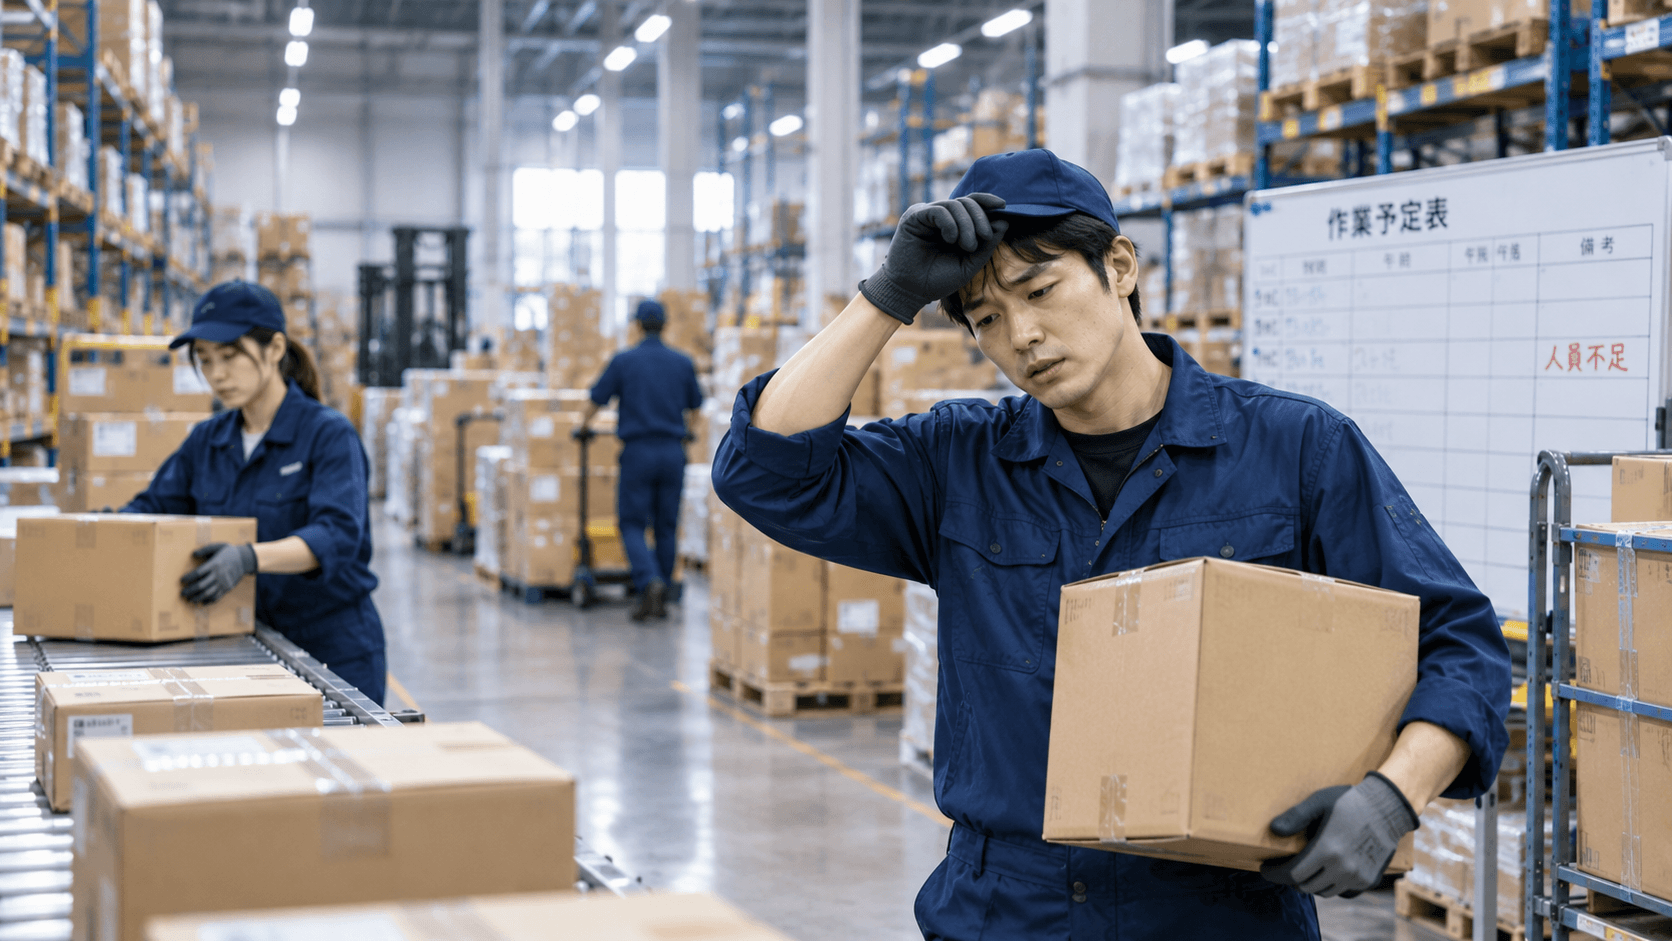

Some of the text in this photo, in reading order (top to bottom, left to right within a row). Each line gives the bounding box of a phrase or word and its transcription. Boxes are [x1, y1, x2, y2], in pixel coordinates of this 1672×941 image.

[1327, 197, 1448, 241] 作業予定表
[1580, 236, 1615, 256] 備考
[1545, 342, 1628, 372] 人員不足
